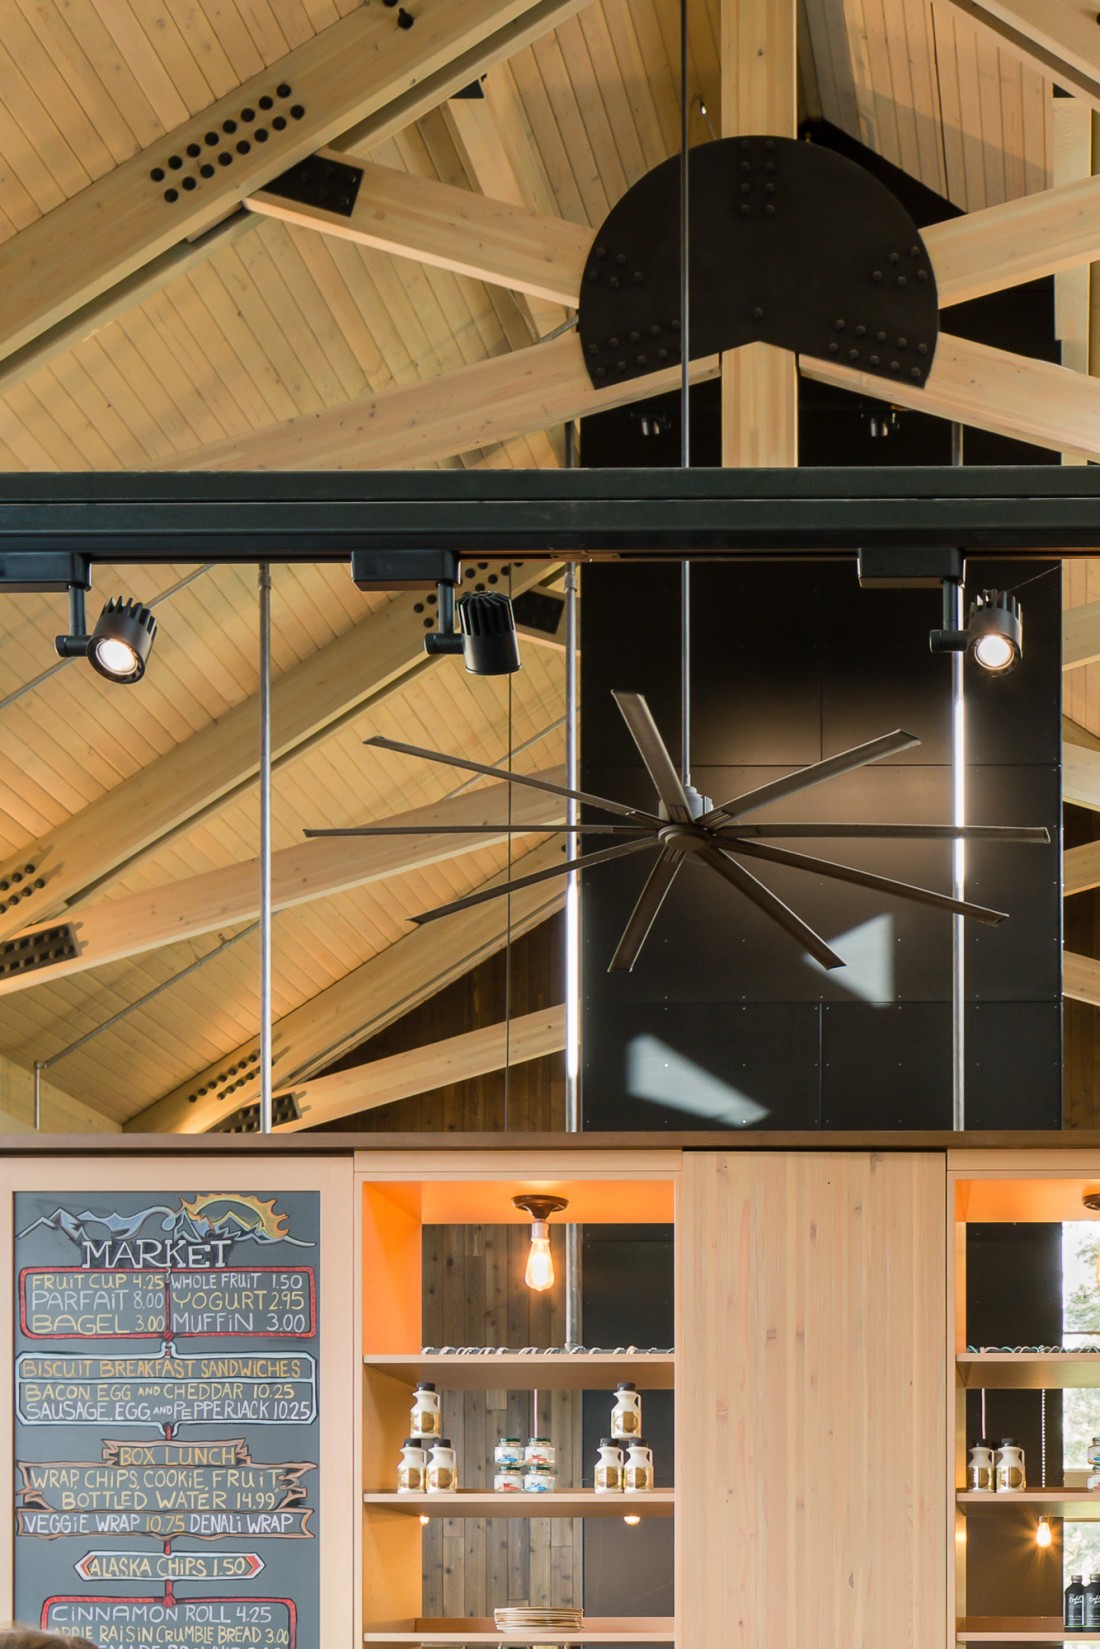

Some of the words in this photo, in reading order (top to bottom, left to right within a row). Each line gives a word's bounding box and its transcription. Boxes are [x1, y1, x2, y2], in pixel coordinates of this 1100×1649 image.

[81, 1239, 232, 1269] MARKET
[88, 1273, 127, 1289] CUP
[132, 1275, 165, 1290] 4.25
[171, 1274, 217, 1290] WHOLE
[271, 1274, 303, 1290] 1.50
[133, 1290, 165, 1310] 8.00
[172, 1290, 268, 1311] YOGURT
[268, 1291, 305, 1311] 2.95
[31, 1314, 131, 1335] BAGEL
[134, 1315, 166, 1332] 3.00
[266, 1313, 306, 1333] 3.00
[99, 1359, 196, 1379] BREAKFAST
[96, 1384, 132, 1401] EGG
[137, 1386, 161, 1397] AND
[163, 1383, 243, 1400] CHEDDAR
[253, 1383, 295, 1399] 10.25
[152, 1405, 173, 1415] AND
[273, 1401, 311, 1420] 10.25
[119, 1447, 156, 1466] BOX
[165, 1447, 236, 1466] LUNCH
[61, 1491, 148, 1510] BOTTLED
[155, 1490, 228, 1510] WATER
[95, 1513, 141, 1533] WRAP
[144, 1515, 185, 1533] 10.75
[246, 1513, 294, 1534] WRAP
[89, 1557, 152, 1578] ALASKA
[213, 1557, 246, 1577] 1.50
[185, 1605, 232, 1623] ROLL
[236, 1605, 273, 1623] 4.25
[217, 1625, 262, 1644] BREAD
